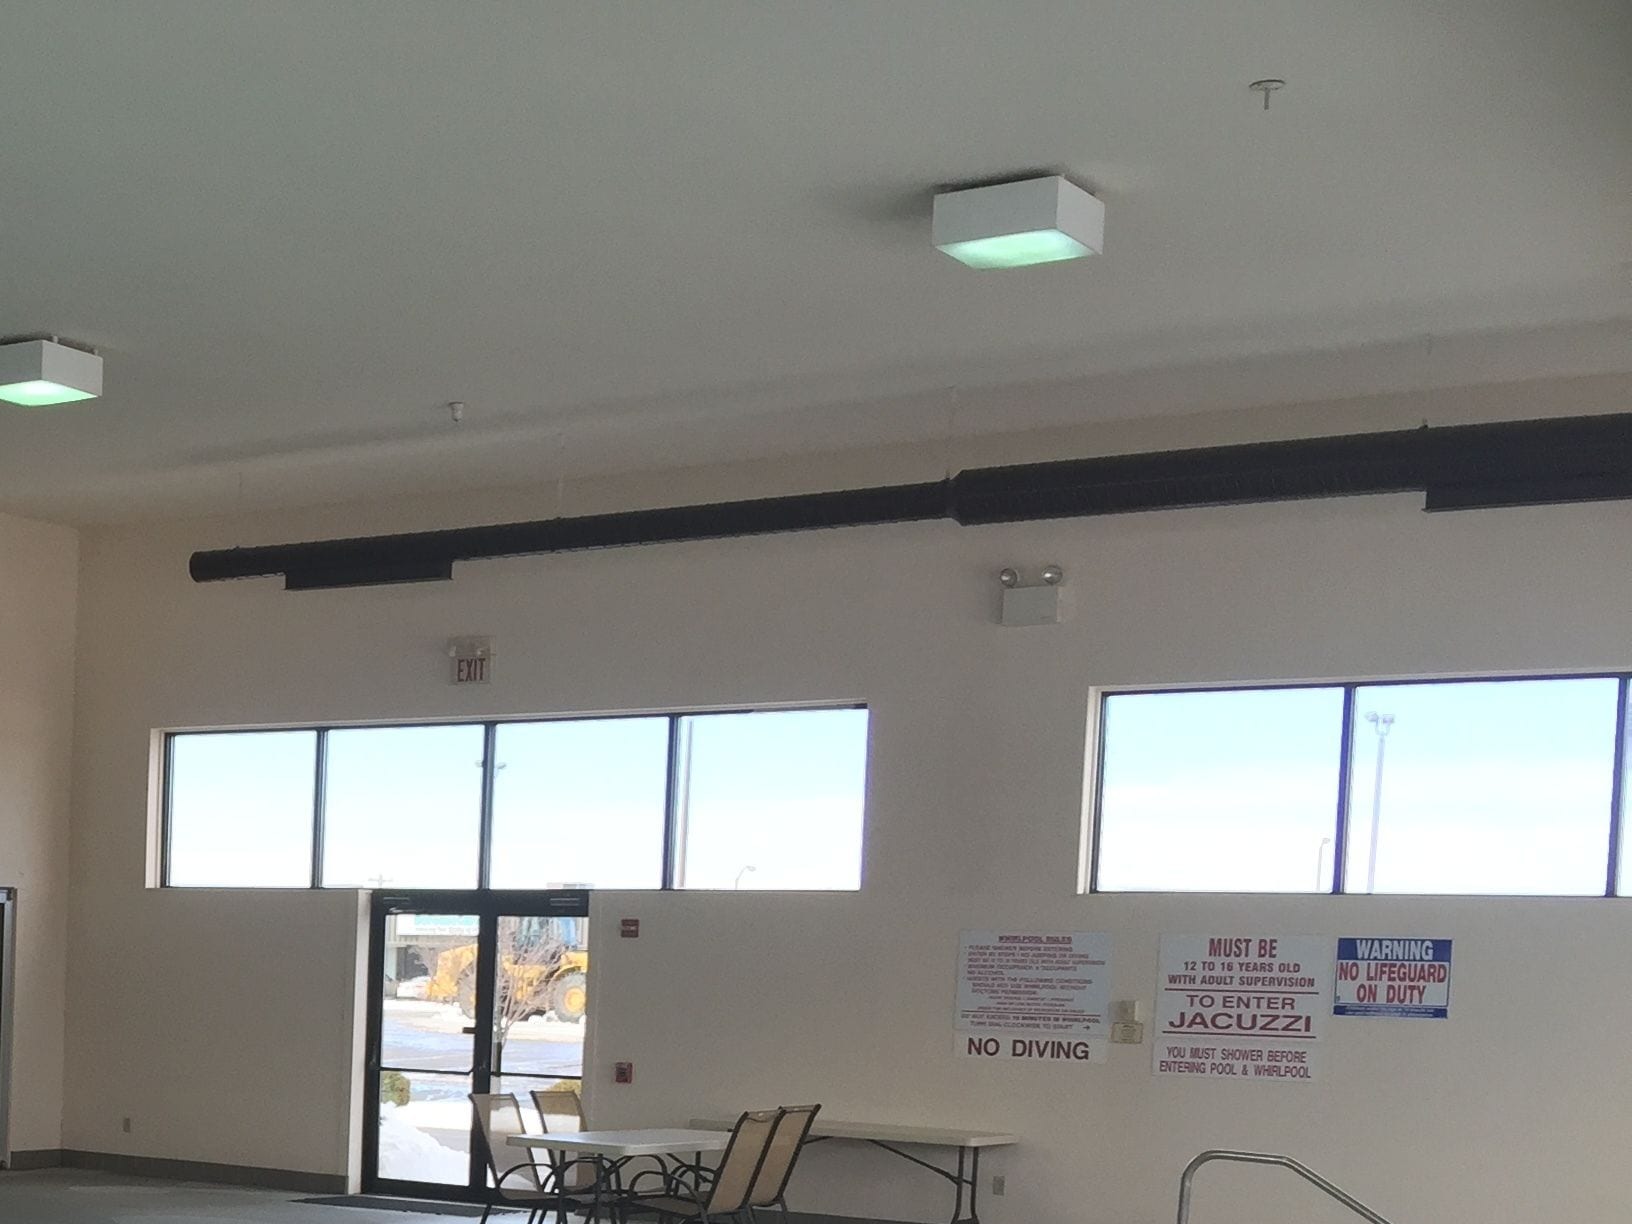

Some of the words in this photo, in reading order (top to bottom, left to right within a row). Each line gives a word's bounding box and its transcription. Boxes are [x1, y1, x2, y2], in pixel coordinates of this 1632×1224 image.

[457, 657, 486, 682] EXIT
[1208, 938, 1252, 957] MUST
[1258, 938, 1278, 958] BE
[1356, 939, 1433, 960] WARNING
[1183, 961, 1197, 971] 12
[1201, 961, 1215, 971] TO
[1238, 962, 1274, 973] YEARS
[1278, 963, 1301, 973] OLD
[1338, 962, 1360, 981] NO
[1366, 962, 1447, 983] LIFEGUARD
[1168, 974, 1196, 984] WITH
[1200, 975, 1235, 985] ADULT
[1238, 976, 1315, 987] SUPERVISION
[1185, 994, 1215, 1008] TO
[1222, 996, 1296, 1010] ENTER
[1356, 983, 1377, 1003] ON
[1386, 984, 1426, 1004] DUTY
[1168, 1012, 1311, 1032] JACUZZI
[968, 1037, 1000, 1057] NO
[1012, 1039, 1089, 1060] DIVING
[1166, 1046, 1186, 1058] YOU
[1190, 1047, 1217, 1060] MUST
[1220, 1048, 1263, 1061] SHOWER
[1266, 1050, 1307, 1063] BEFORE
[1159, 1060, 1206, 1074] ENTERING
[1210, 1062, 1237, 1075] POOL
[1241, 1064, 1249, 1076] &
[1253, 1065, 1312, 1079] WHIRLPOOL
